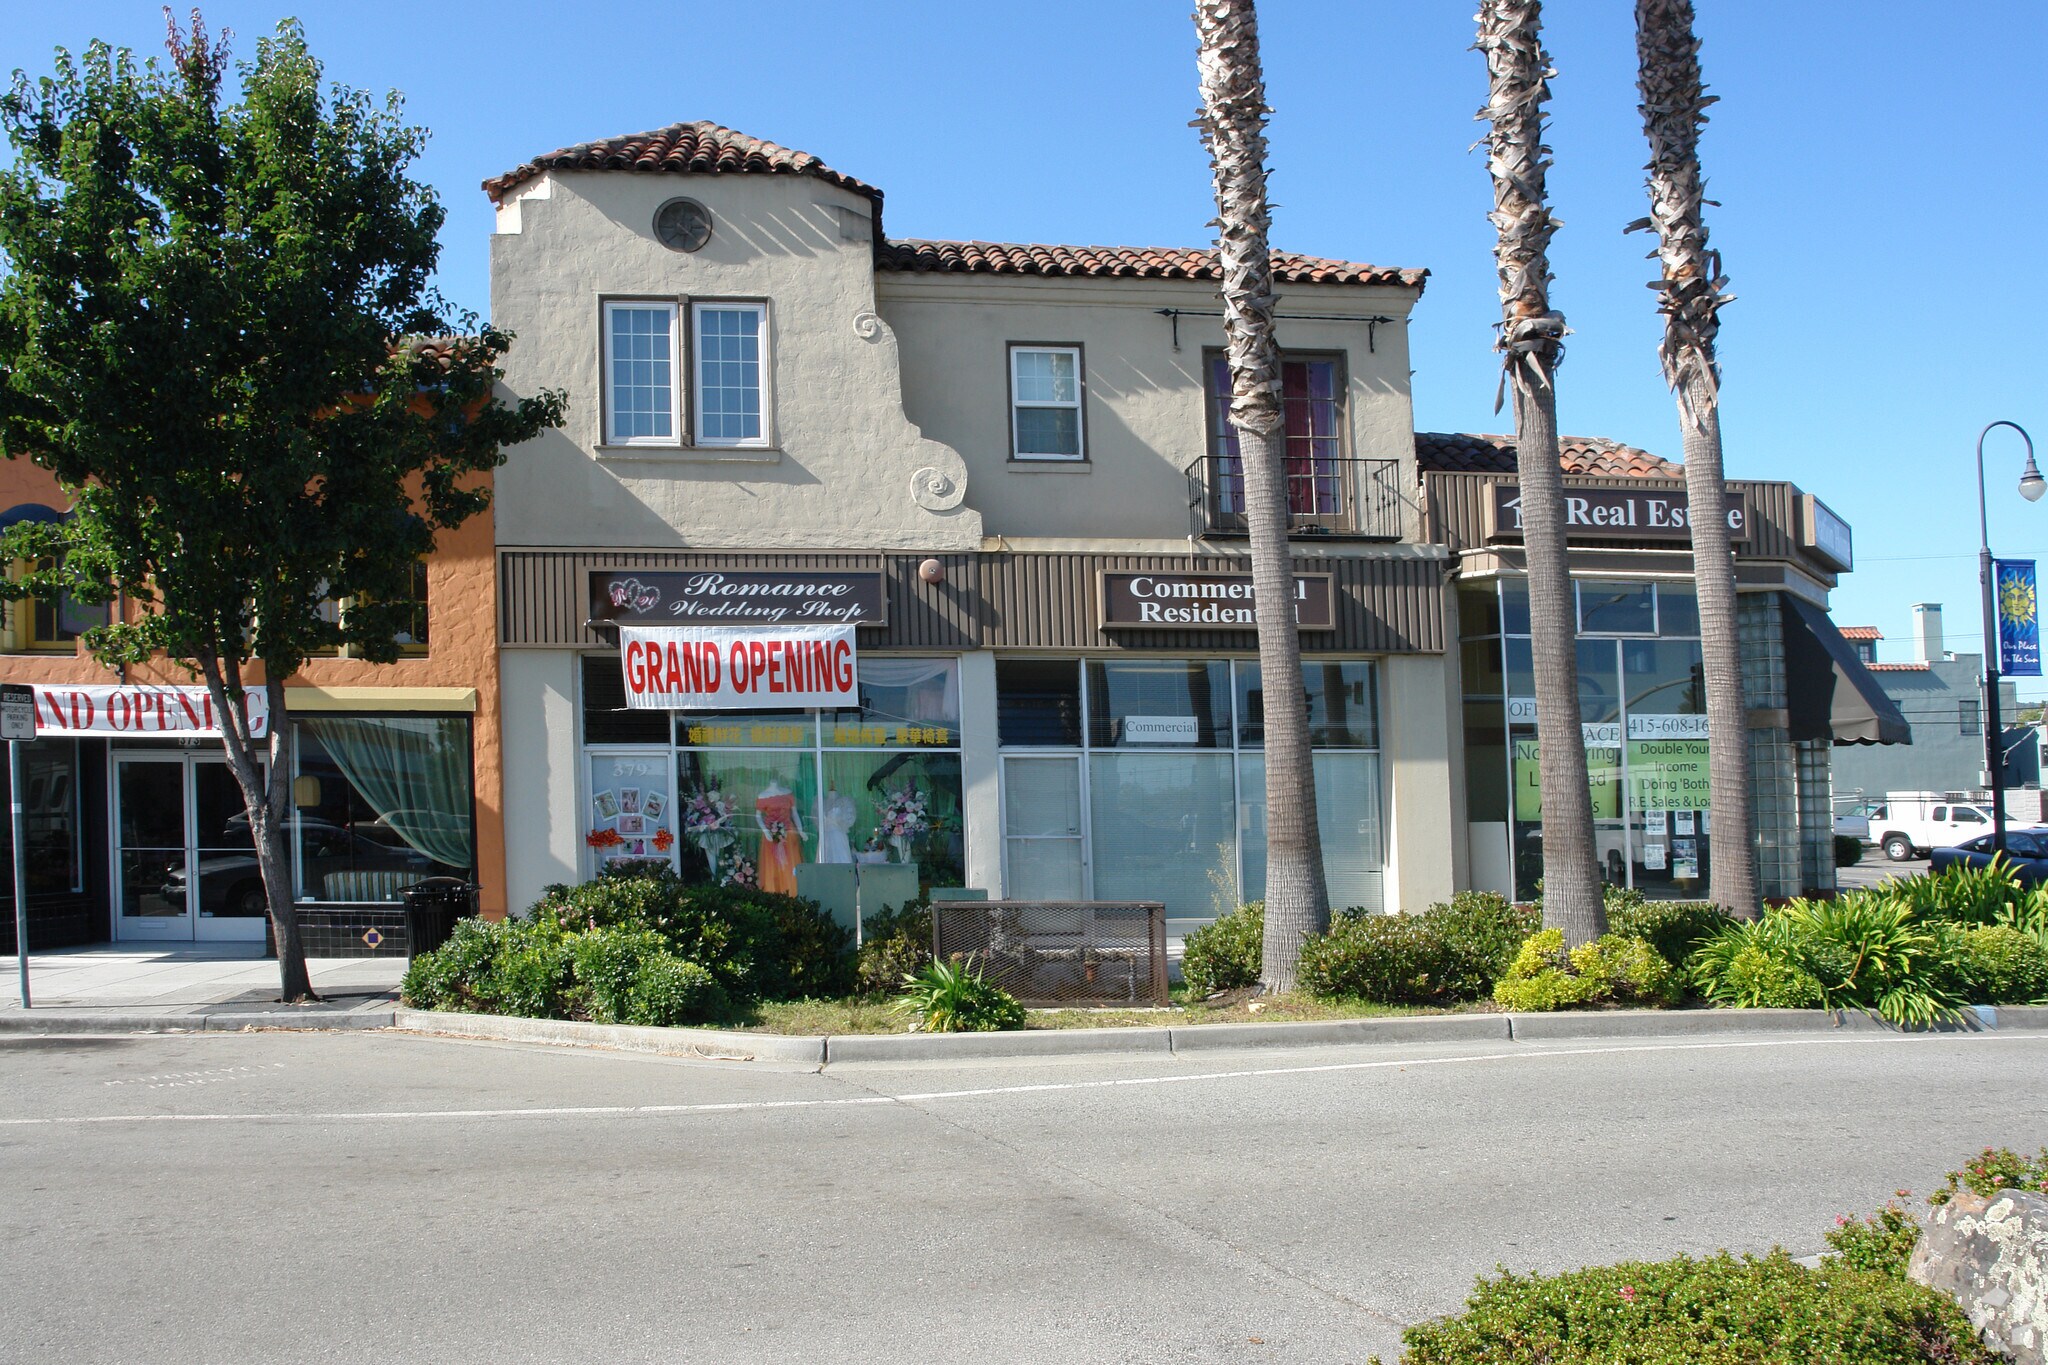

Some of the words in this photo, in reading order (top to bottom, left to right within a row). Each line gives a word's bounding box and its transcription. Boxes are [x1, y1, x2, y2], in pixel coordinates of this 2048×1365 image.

[1565, 497, 1637, 526] Real
[1646, 500, 1743, 529] Este
[684, 573, 855, 597] Romance
[1129, 577, 1307, 600] Commerl
[669, 600, 793, 623] Wedding
[796, 600, 868, 622] Shop
[2003, 641, 2016, 650] Our
[2018, 640, 2037, 650] Place
[2012, 654, 2023, 662] The
[2023, 654, 2039, 663] Sun
[626, 640, 721, 694] GRAND
[729, 639, 853, 694] OPENING
[106, 691, 262, 732] OPENIG
[1125, 720, 1197, 733] Commercial
[1628, 718, 1709, 732] 415-608-16
[1641, 743, 1683, 754] Double
[613, 764, 648, 776] 379
[1655, 762, 1698, 772] Income
[1642, 778, 1677, 792] Doing
[1651, 796, 1680, 808] Sales
[1683, 796, 1692, 808] &
